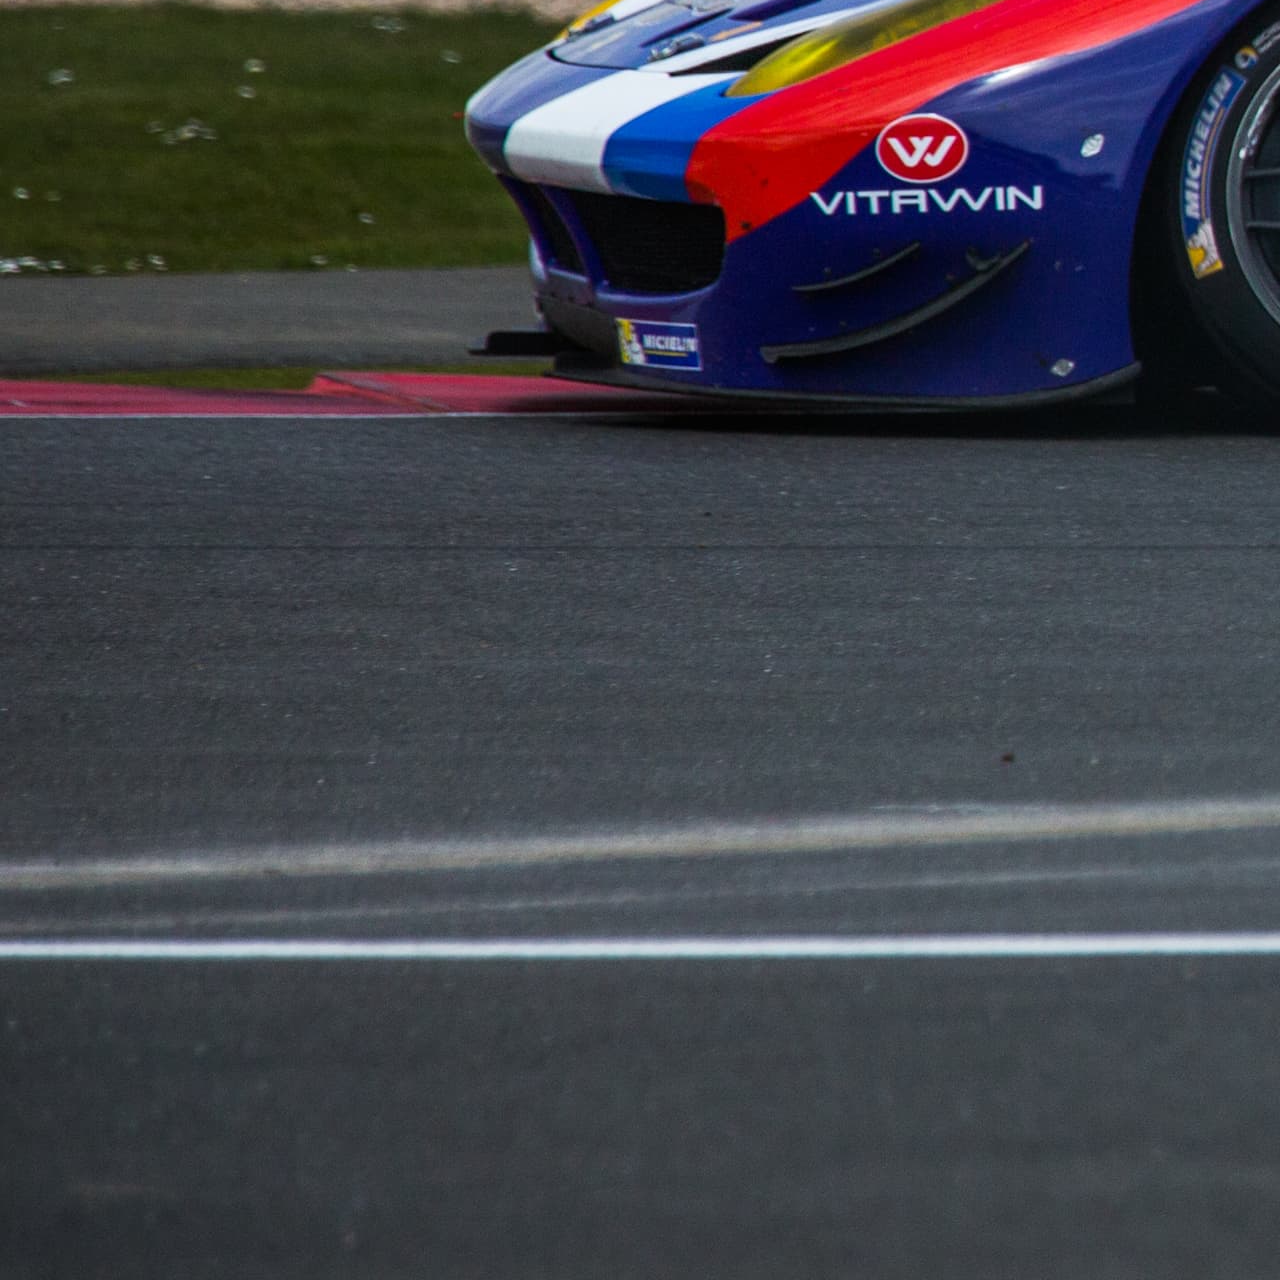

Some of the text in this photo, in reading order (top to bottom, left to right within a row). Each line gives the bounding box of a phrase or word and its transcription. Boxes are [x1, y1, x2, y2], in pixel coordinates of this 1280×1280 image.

[1184, 73, 1232, 219] MICHELIN
[810, 185, 1043, 215] VITAWIN
[643, 333, 697, 352] MICHELIN
